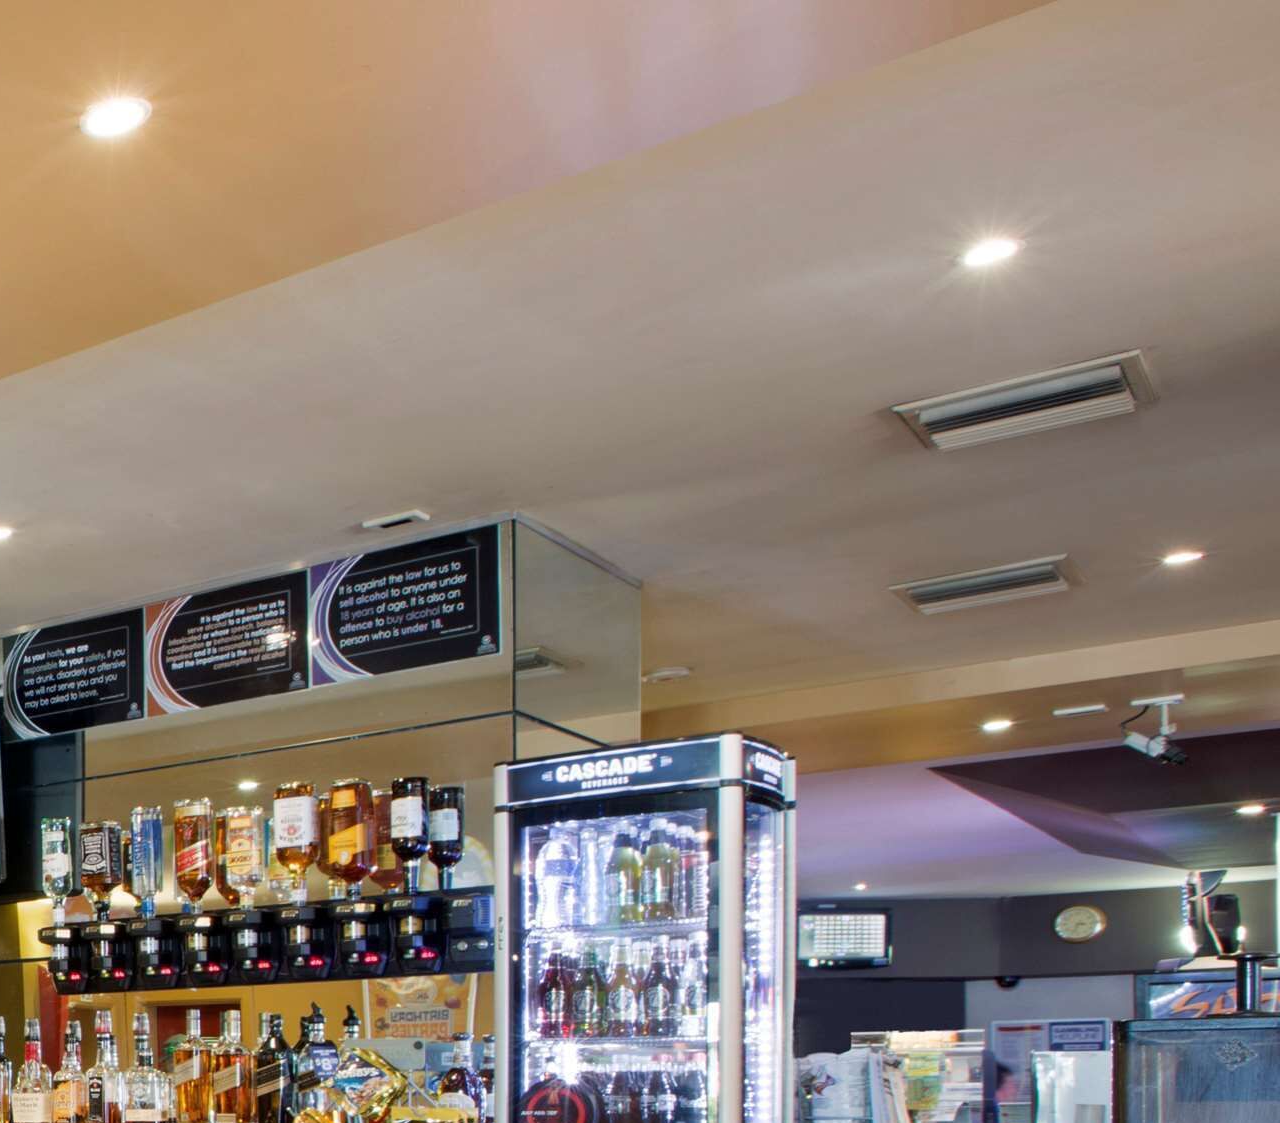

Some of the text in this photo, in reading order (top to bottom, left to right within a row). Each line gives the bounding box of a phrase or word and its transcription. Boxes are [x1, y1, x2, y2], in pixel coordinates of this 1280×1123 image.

[339, 562, 461, 595] It is against the law for us to
[339, 574, 468, 608] sell alcohol to anyone under
[339, 602, 464, 634] offence to buy alcohol for a
[351, 607, 374, 620] years
[376, 603, 386, 613] of
[410, 597, 416, 606] It
[418, 596, 424, 604] is
[426, 592, 445, 603] also
[447, 590, 461, 599] an
[339, 635, 370, 648] person
[371, 630, 391, 640] who
[393, 627, 399, 636] is
[401, 622, 429, 635] under
[23, 656, 31, 664] As
[32, 653, 46, 662] your
[65, 647, 75, 655] we
[77, 644, 89, 653] are
[36, 687, 45, 695] will
[46, 684, 56, 693] not
[58, 682, 75, 691] serve
[77, 679, 89, 689] you
[90, 675, 103, 685] and
[105, 674, 118, 684] you
[25, 701, 39, 709] may
[40, 698, 49, 706] be
[50, 694, 69, 705] asked
[70, 692, 77, 700] to
[555, 754, 654, 783] CASCADE
[581, 776, 629, 790] BEVERAGES
